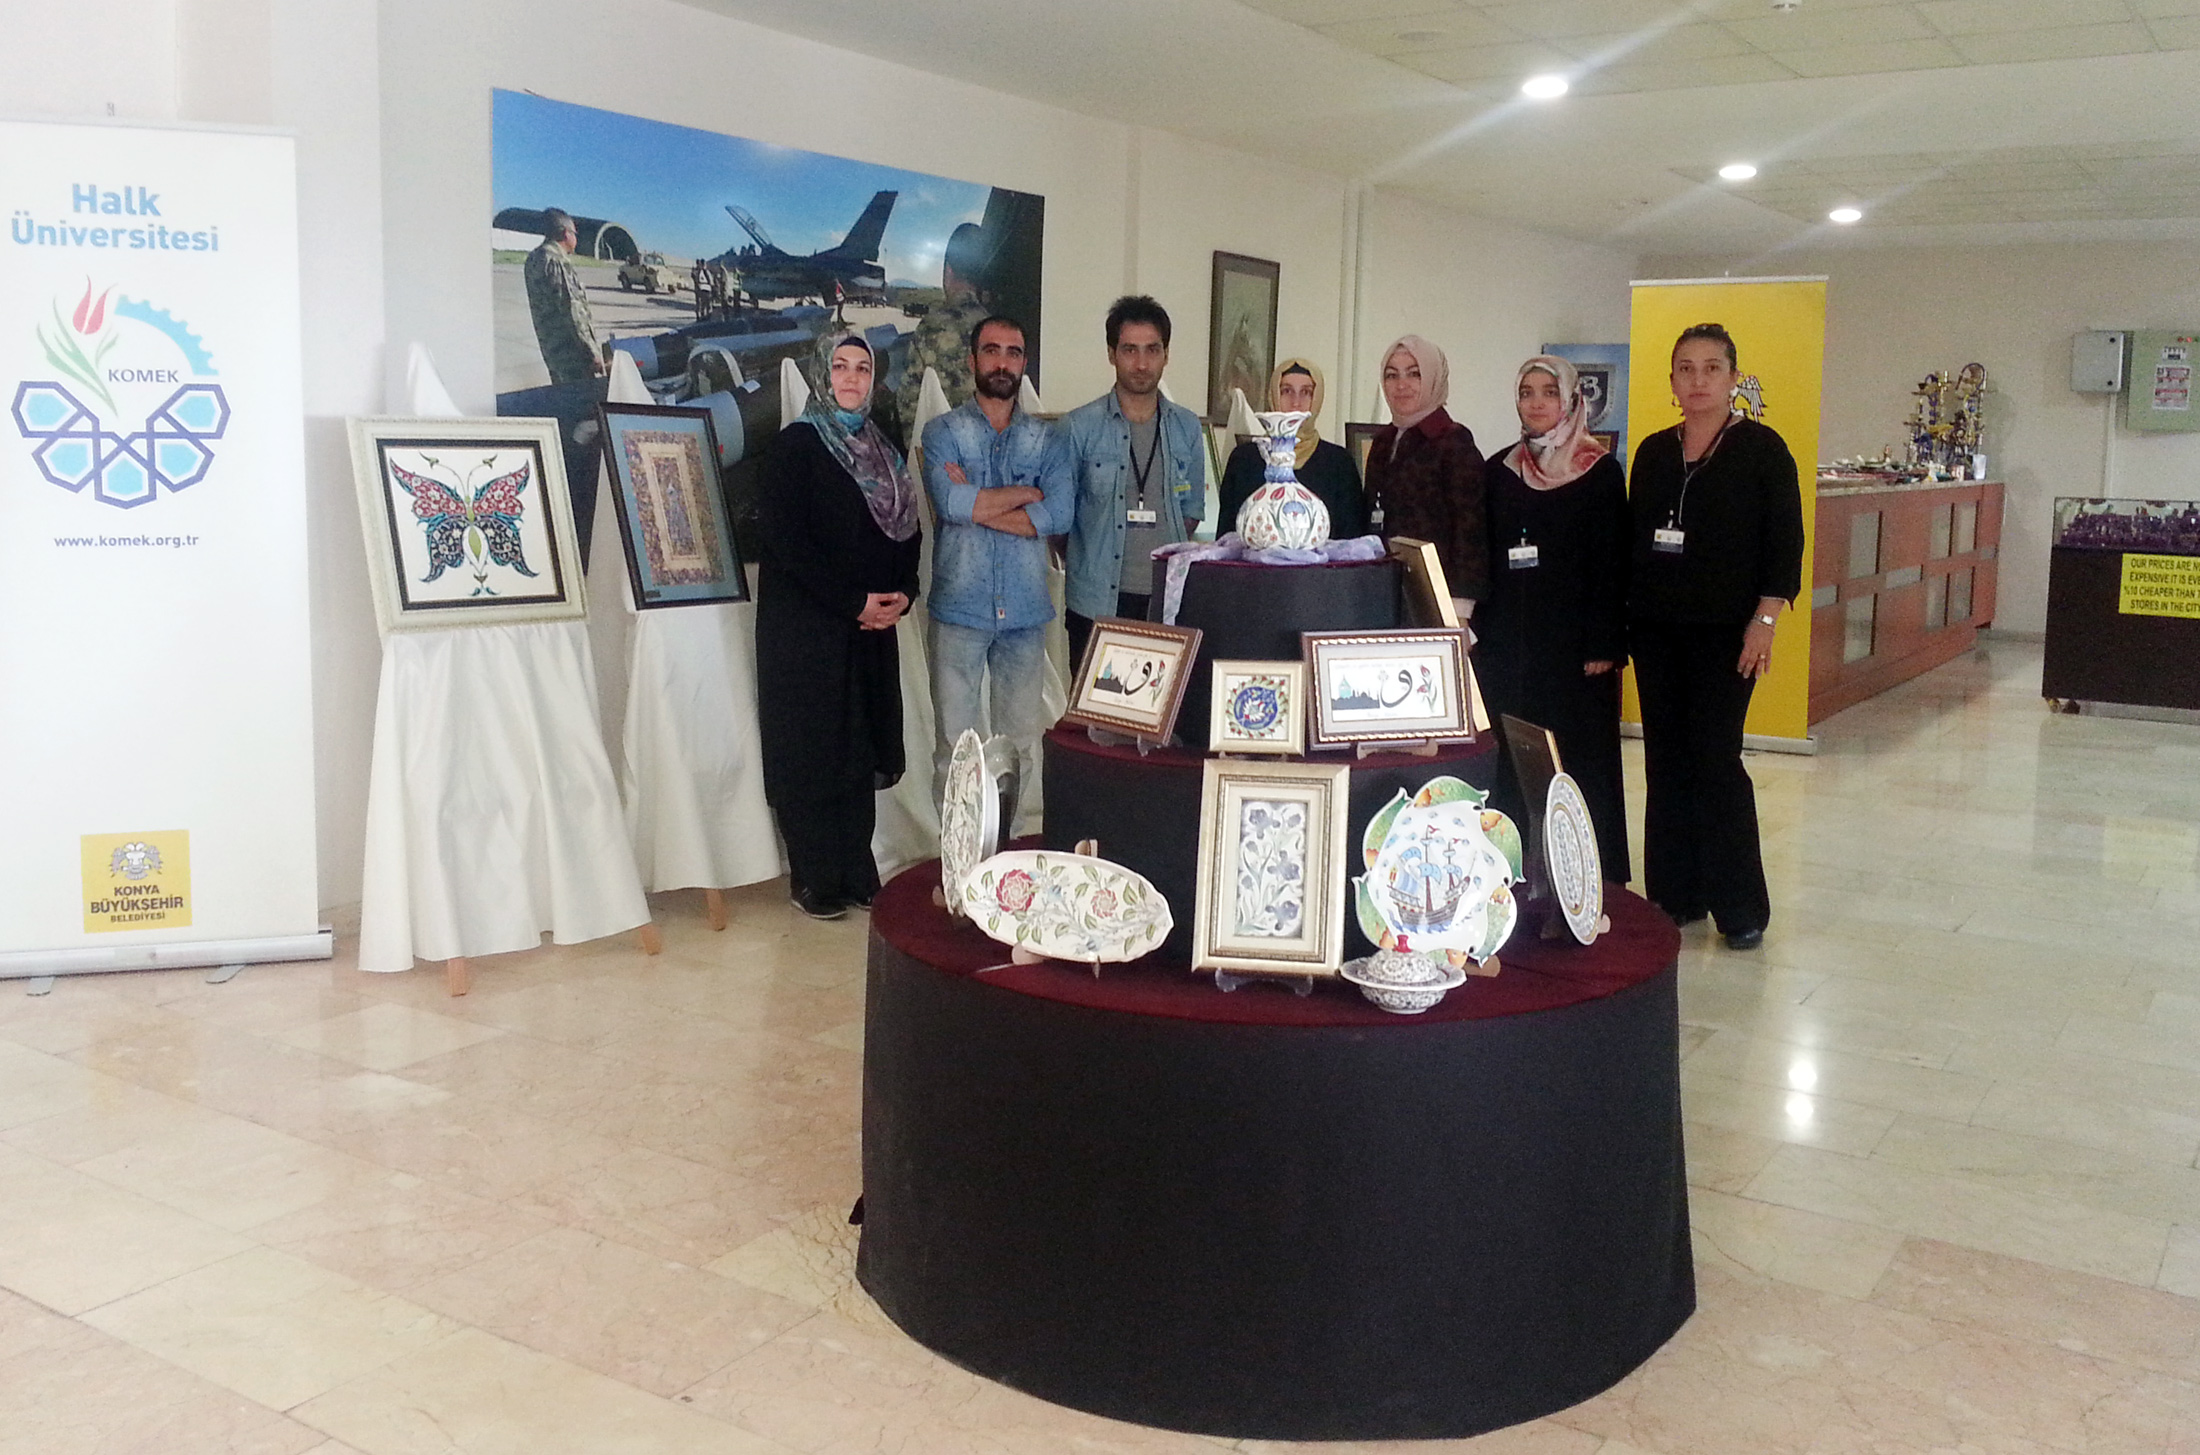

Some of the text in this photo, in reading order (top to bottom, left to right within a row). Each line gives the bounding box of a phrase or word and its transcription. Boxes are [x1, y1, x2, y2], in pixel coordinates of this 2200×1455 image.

[72, 183, 162, 216] Halk
[11, 210, 219, 251] Üniversitesi
[108, 369, 179, 383] KOMEK
[54, 535, 199, 548] www.komek.org.tr
[2130, 558, 2147, 568] OUR
[2148, 559, 2175, 570] PRICES
[2176, 560, 2191, 571] ARE
[2129, 571, 2169, 584] EXPENSIVE
[2171, 574, 2178, 584] IT
[2179, 574, 2187, 585] IS
[2139, 586, 2174, 598] CHEAPER
[2176, 588, 2196, 599] THAN
[2130, 599, 2159, 611] STORES
[2160, 601, 2168, 610] IN
[2170, 601, 2184, 612] THE
[114, 885, 160, 896] KONYA
[90, 895, 184, 914] BÜYÜKŞEHİR
[110, 912, 165, 923] BELEDİYESİ
